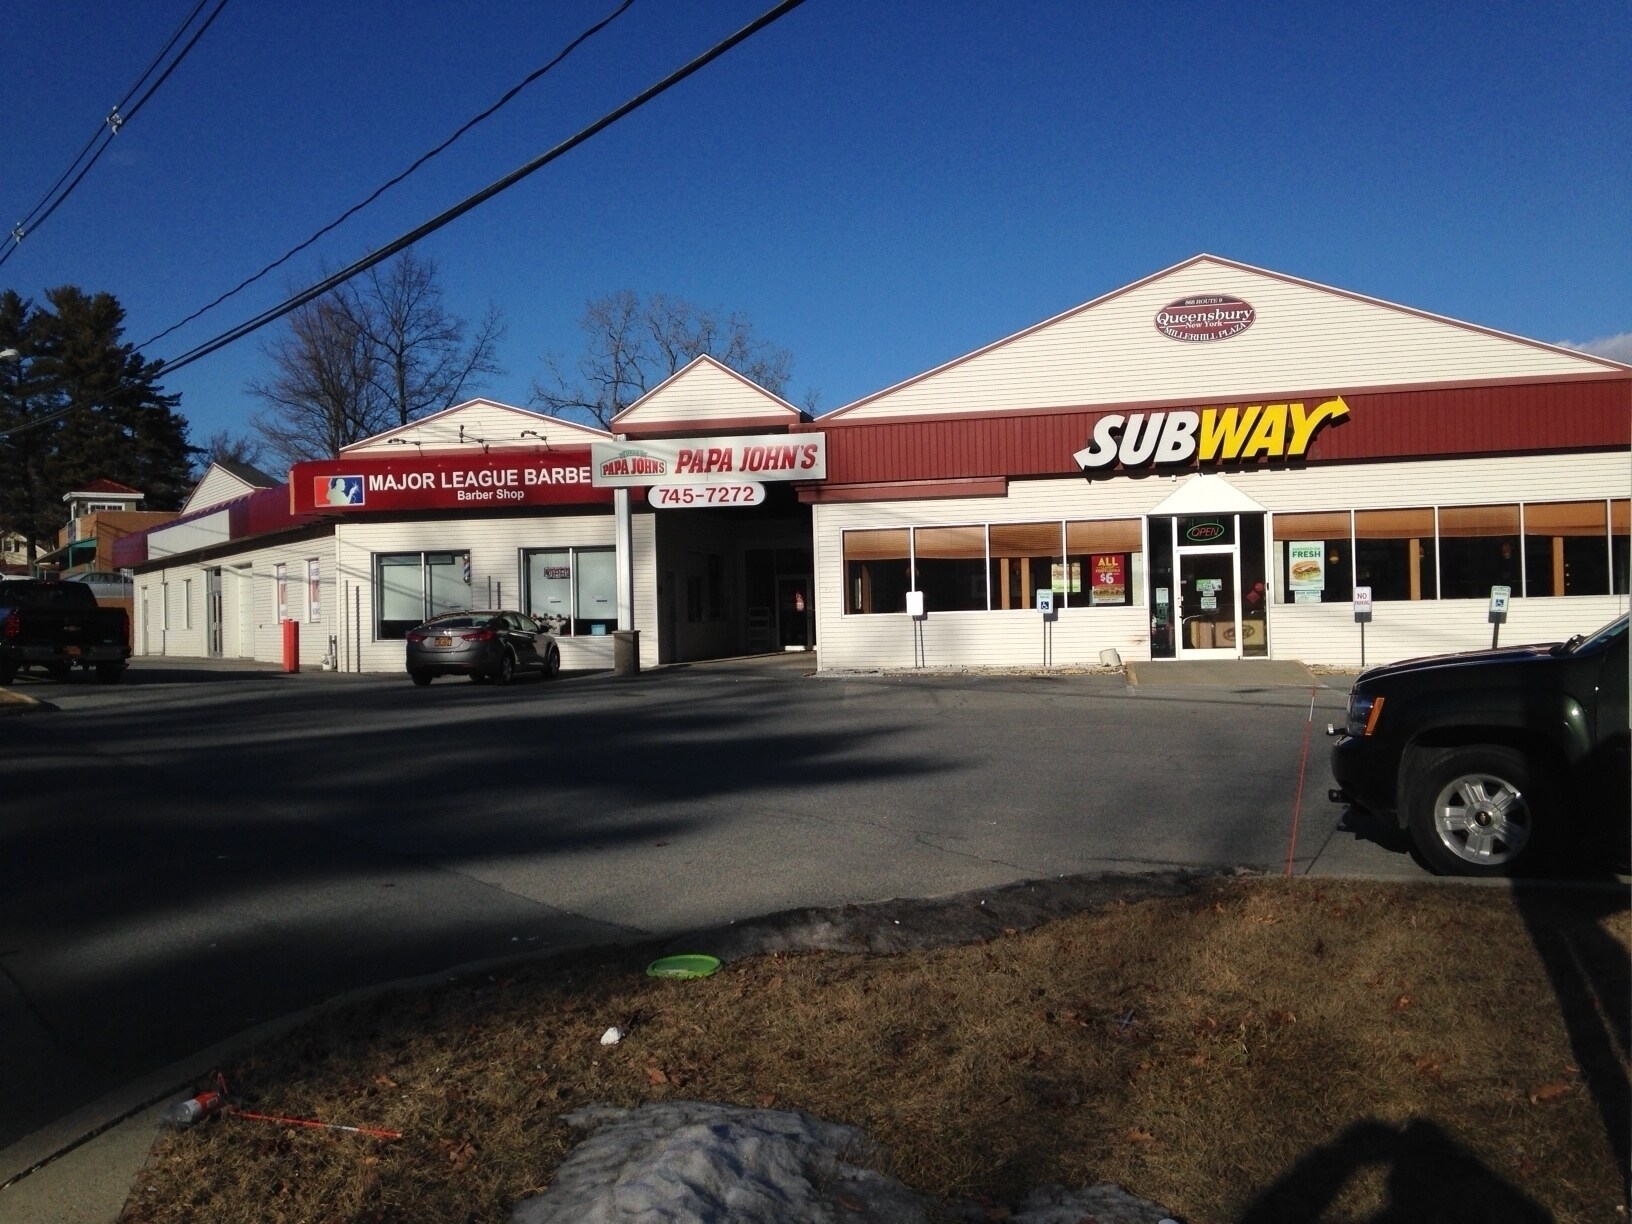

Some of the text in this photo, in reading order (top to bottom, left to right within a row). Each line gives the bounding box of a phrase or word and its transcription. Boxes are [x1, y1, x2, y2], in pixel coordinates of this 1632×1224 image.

[1156, 308, 1253, 326] Queensbury
[1204, 320, 1223, 328] York
[1218, 322, 1246, 338] PLAZA
[1073, 395, 1350, 470] SUBWAY
[675, 443, 818, 474] PAPA JOHN'S
[602, 458, 630, 476] PAPA
[369, 466, 592, 491] MAJOR LEAGUE BARBE
[457, 488, 525, 501] Barber Shop
[659, 486, 755, 504] 745-7272
[1191, 527, 1220, 537] OPEN
[1097, 556, 1119, 567] ALL
[1100, 572, 1115, 585] $6
[1357, 592, 1368, 600] NO
